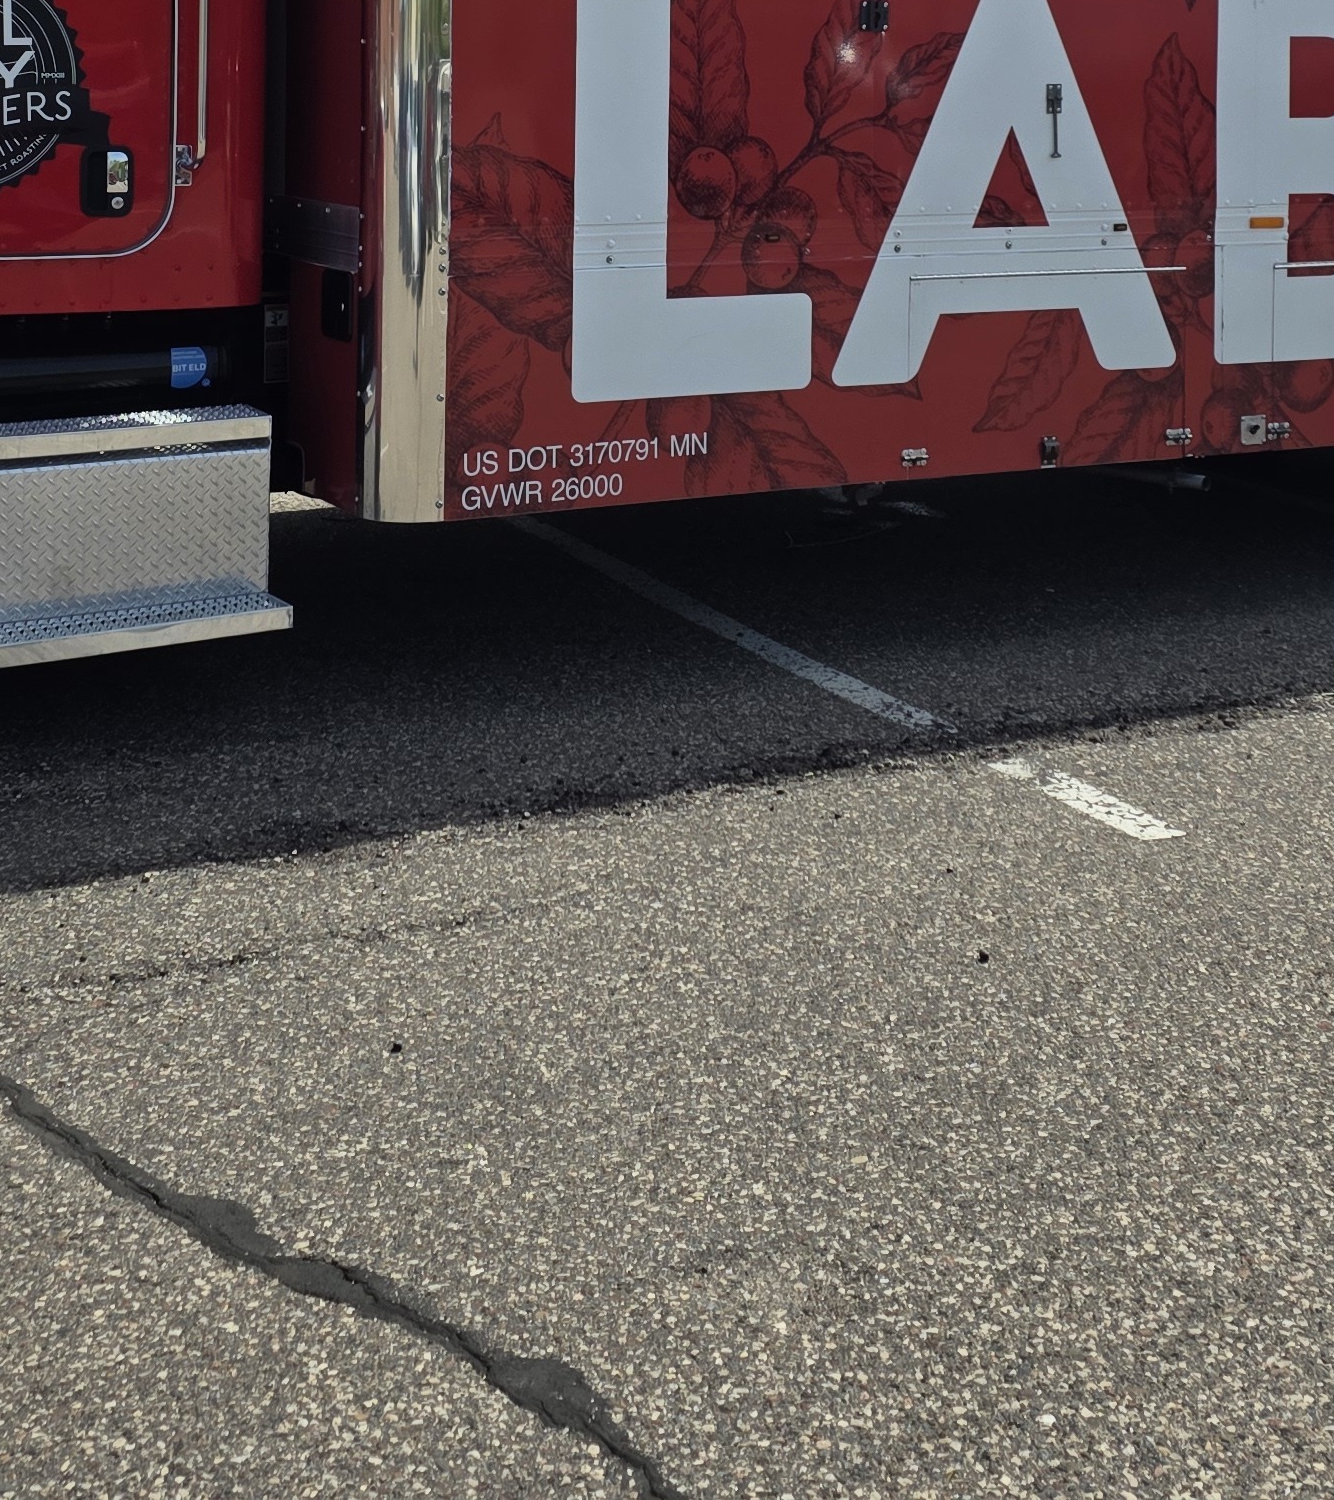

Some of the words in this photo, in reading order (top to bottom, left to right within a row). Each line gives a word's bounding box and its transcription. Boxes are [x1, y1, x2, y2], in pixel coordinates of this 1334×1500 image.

[10, 134, 47, 166] ROASTIN
[463, 450, 499, 477] US
[508, 444, 563, 473] DOT
[569, 437, 659, 467] 3170791
[670, 432, 708, 457] MN
[461, 480, 543, 510] GVWR
[551, 473, 623, 502] 26000
